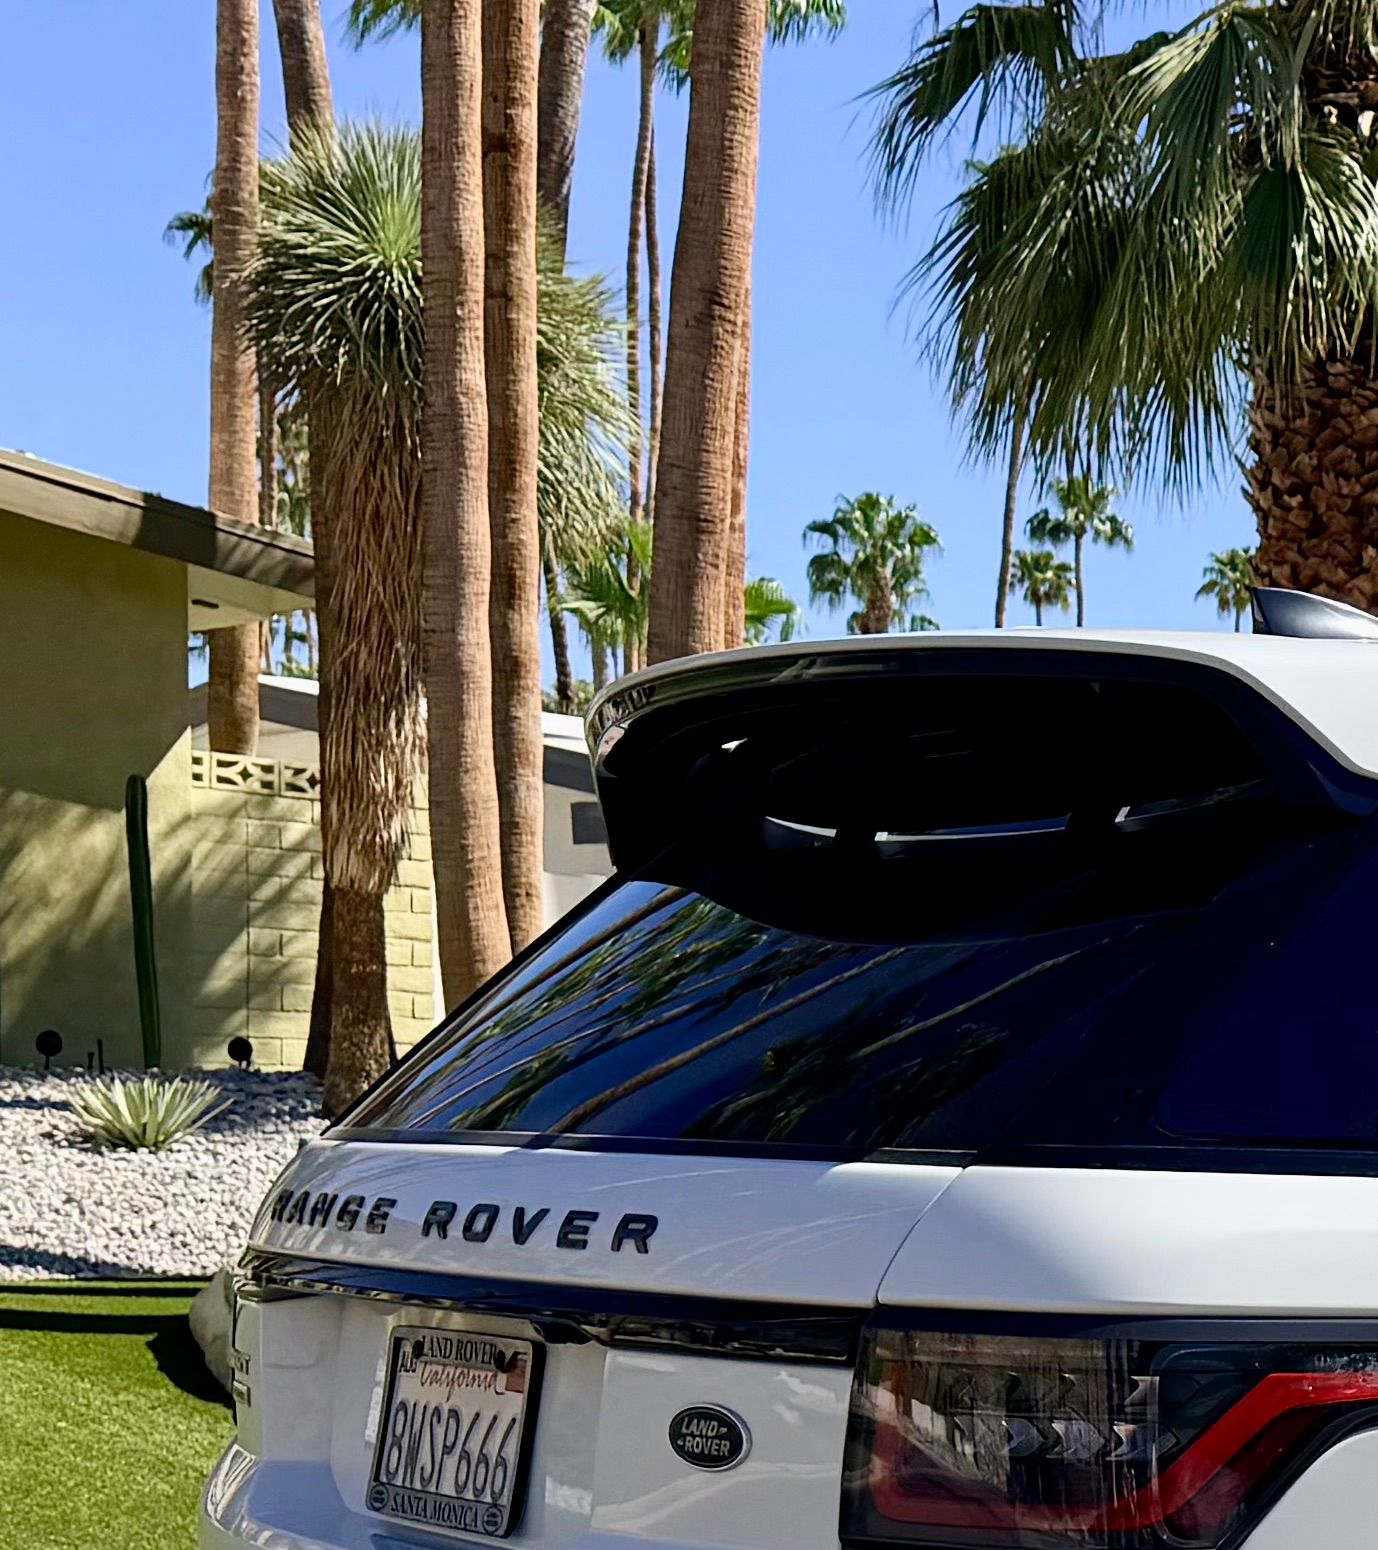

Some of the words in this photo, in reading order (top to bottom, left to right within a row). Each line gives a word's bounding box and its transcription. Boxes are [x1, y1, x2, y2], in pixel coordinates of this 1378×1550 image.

[270, 1188, 397, 1235] RANGE
[421, 1200, 660, 1255] ROVER
[421, 1335, 454, 1360] LAND
[420, 1361, 499, 1402] California
[681, 1416, 719, 1438] LAND
[385, 1400, 517, 1501] 8WSP666
[684, 1436, 731, 1457] ROVER
[391, 1492, 428, 1520] SANTA
[430, 1500, 479, 1529] MONICA
